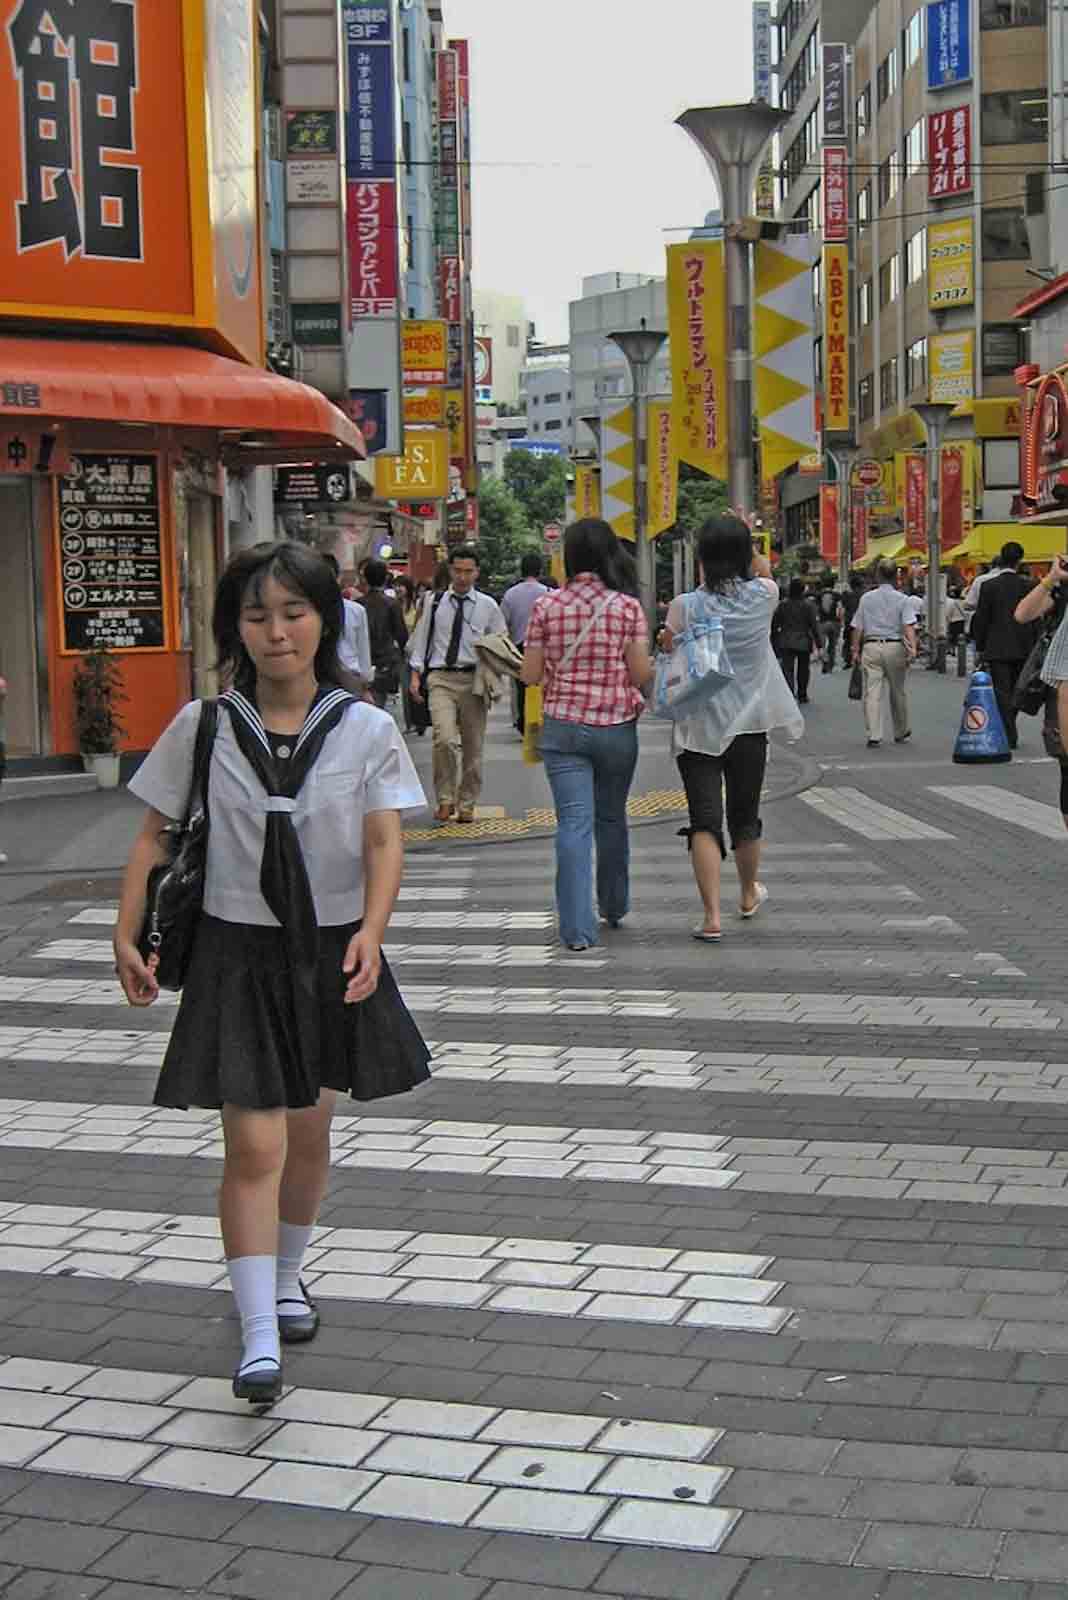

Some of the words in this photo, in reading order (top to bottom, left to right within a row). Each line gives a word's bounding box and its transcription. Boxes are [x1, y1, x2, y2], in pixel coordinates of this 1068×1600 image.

[349, 24, 379, 38] 3F
[7, 0, 144, 264] 館
[934, 114, 949, 194] リーブ21
[351, 302, 394, 314] 3F
[684, 256, 706, 369] ウルトラマン
[827, 256, 846, 417] ABC-MART
[85, 464, 152, 484] 大黒屋
[88, 590, 136, 602] エルメス
